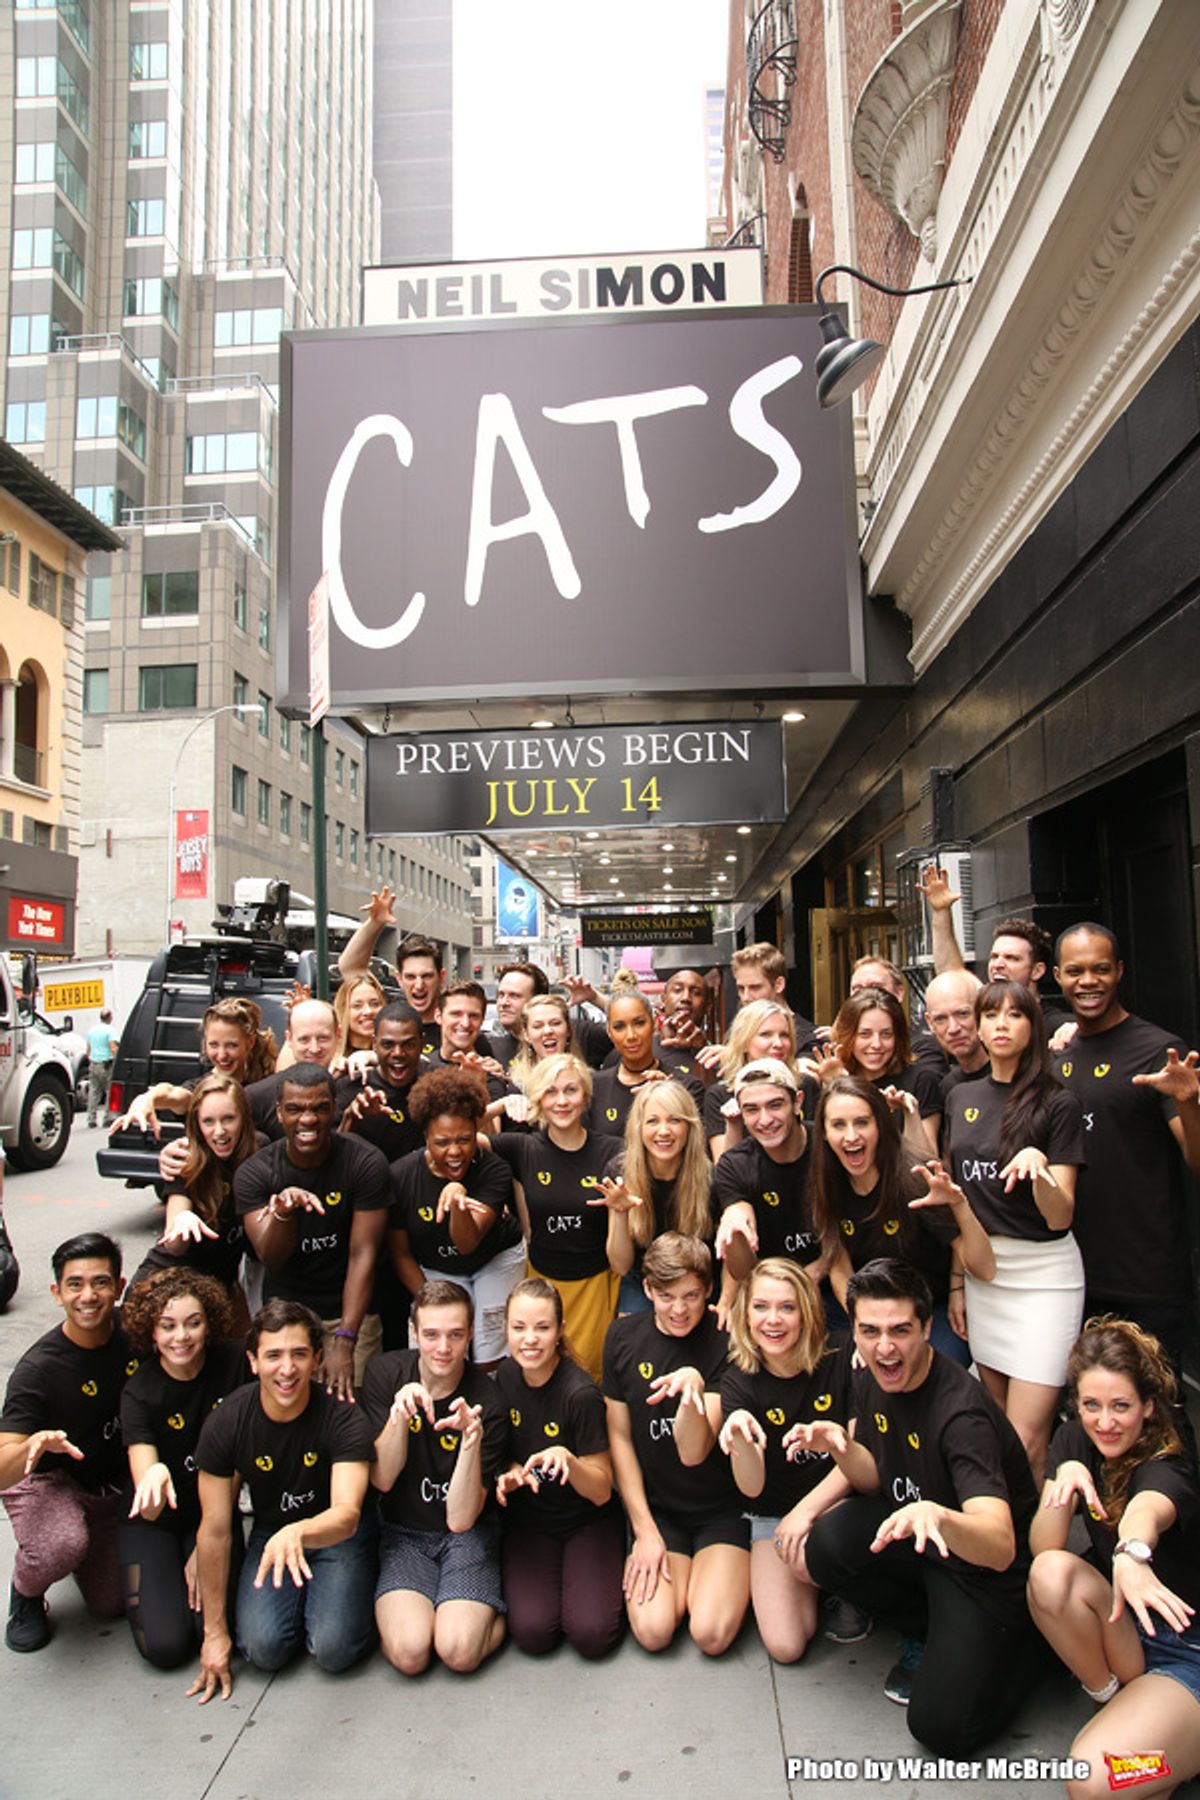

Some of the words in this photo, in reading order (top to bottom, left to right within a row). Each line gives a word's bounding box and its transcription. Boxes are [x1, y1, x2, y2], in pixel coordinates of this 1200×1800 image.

[398, 273, 517, 319] NEIL
[539, 262, 727, 311] SIMON
[321, 355, 803, 650] CATS
[396, 735, 606, 775] PREVIEWS
[622, 730, 752, 766] BEGIN
[486, 777, 597, 826] JULY
[620, 775, 662, 813] 14
[22, 904, 35, 919] The
[36, 906, 53, 921] New
[18, 919, 34, 935] York
[36, 922, 56, 938] Times
[585, 918, 631, 932] TICKETS
[632, 919, 649, 930] ON
[651, 918, 679, 930] SALE
[681, 916, 708, 928] NOW
[601, 930, 694, 942] TICKETMASTER.COM
[48, 984, 102, 1008] PLAYBILL
[961, 1159, 998, 1182] CATS
[546, 1215, 583, 1234] CATS
[301, 1233, 338, 1252] CATS
[649, 1417, 676, 1441] CAT
[280, 1490, 315, 1512] CATS
